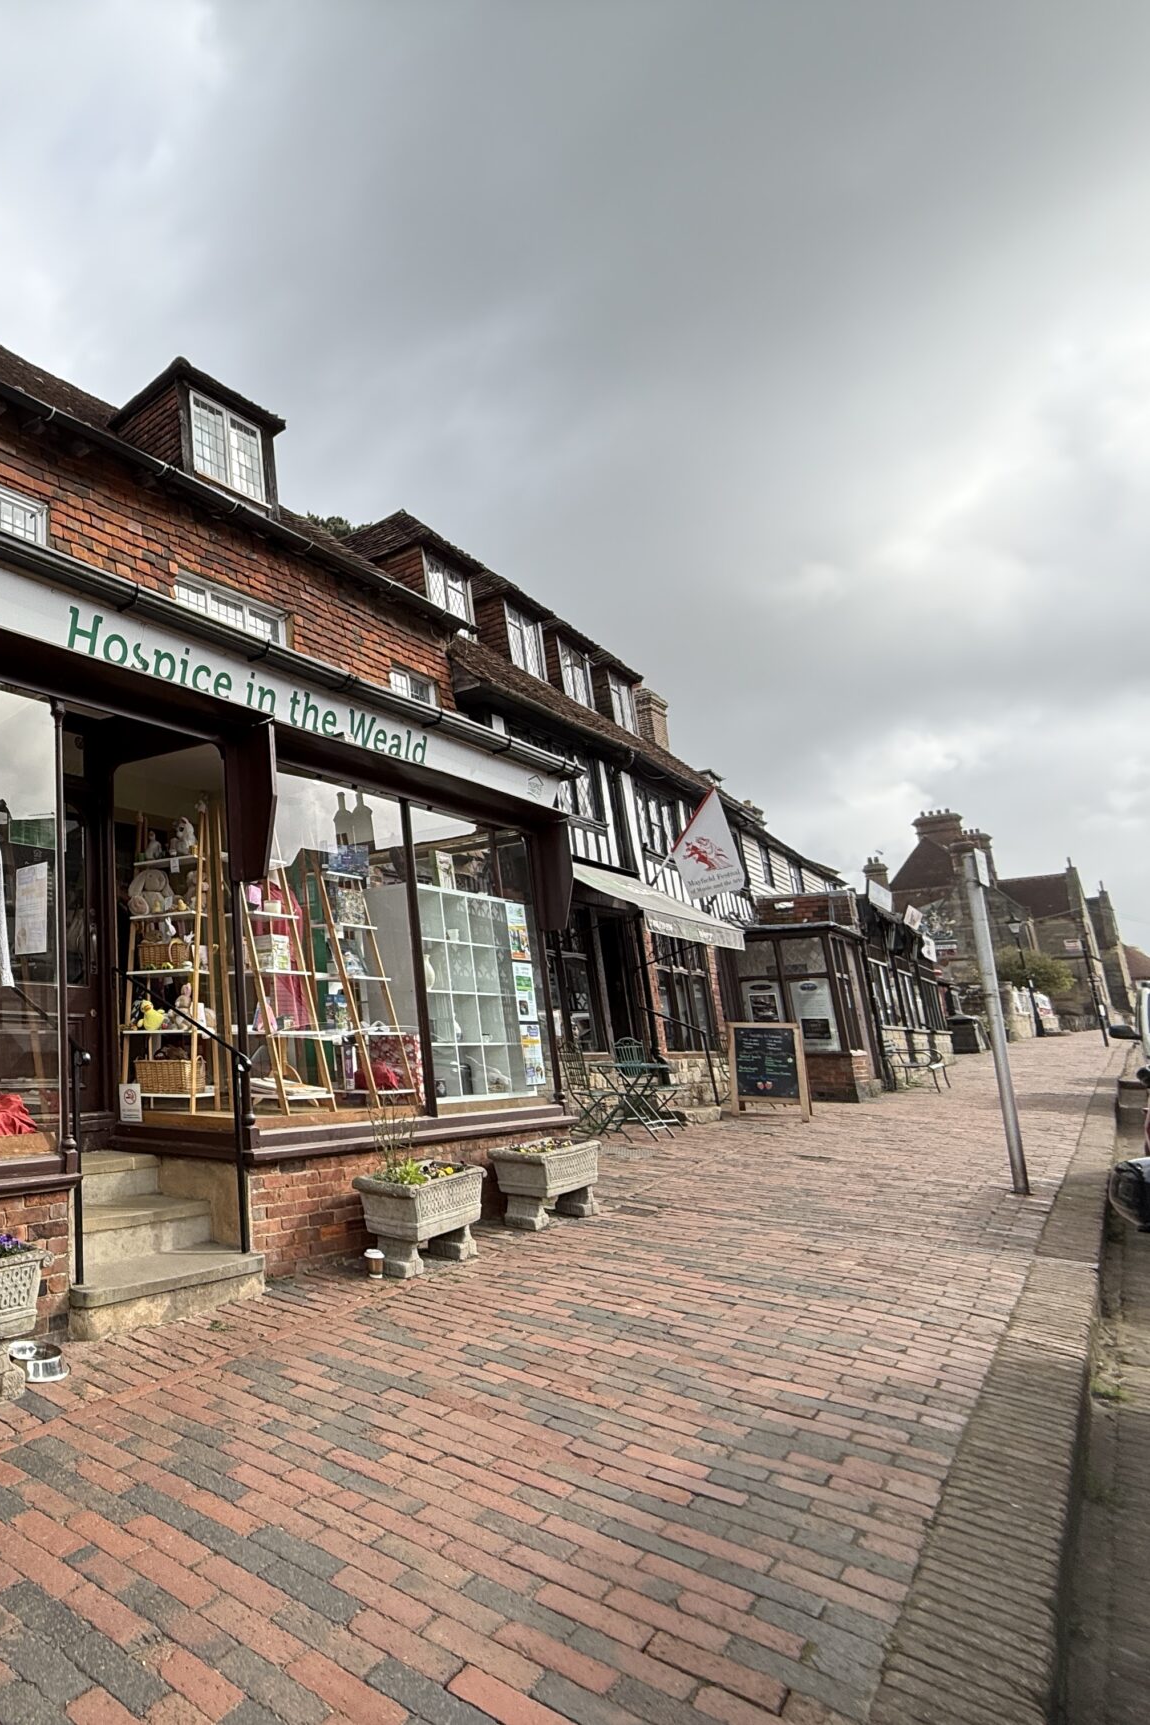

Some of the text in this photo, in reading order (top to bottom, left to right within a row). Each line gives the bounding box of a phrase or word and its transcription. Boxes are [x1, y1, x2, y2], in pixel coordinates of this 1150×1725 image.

[68, 605, 428, 765] Hospice in the Weald
[687, 868, 740, 886] Mayfield Festival
